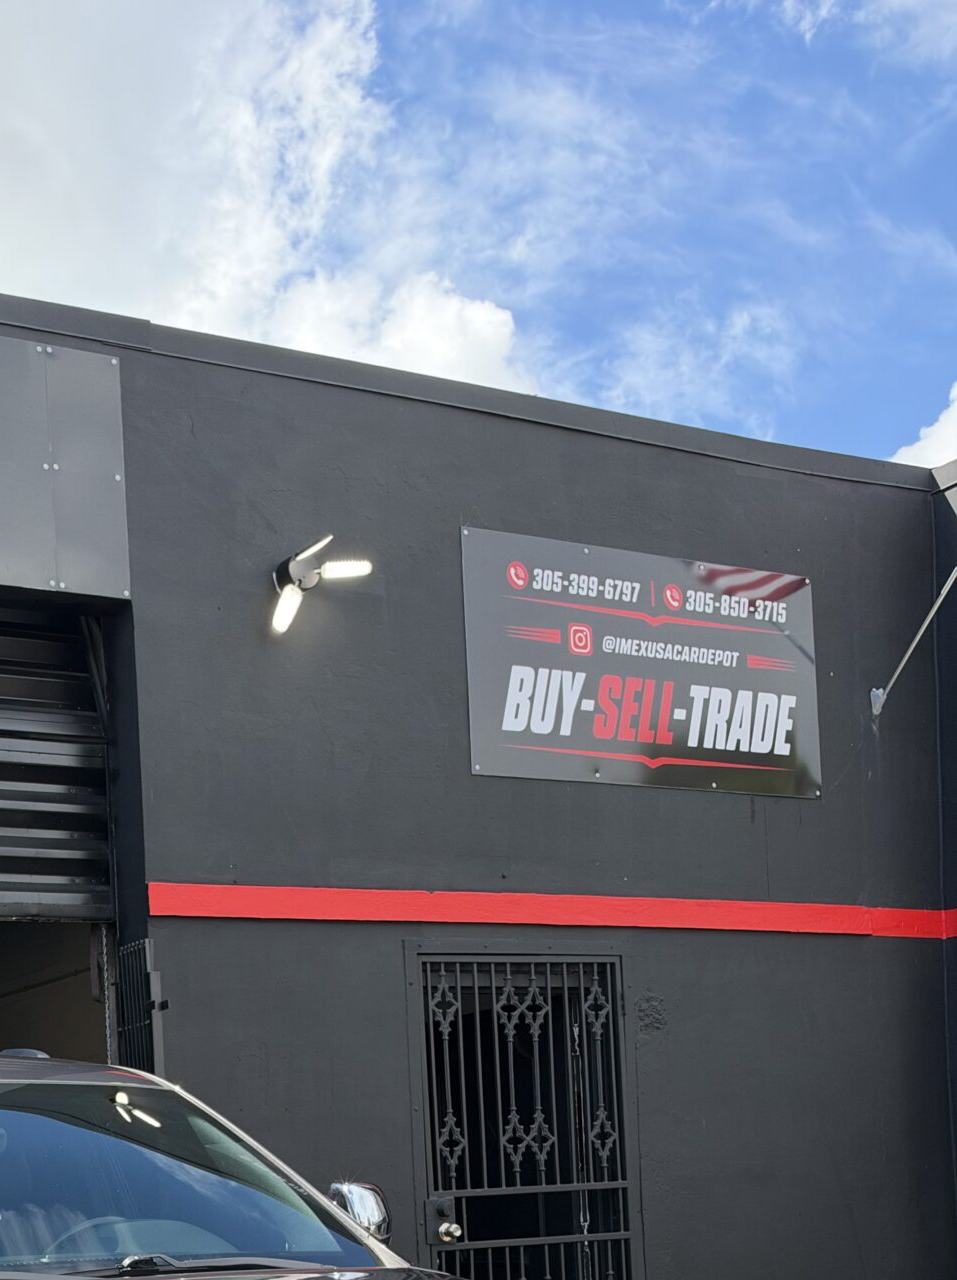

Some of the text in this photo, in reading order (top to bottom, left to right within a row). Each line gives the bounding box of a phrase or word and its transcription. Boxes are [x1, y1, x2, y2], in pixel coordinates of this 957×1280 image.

[532, 568, 787, 623] 305-399-6797 305-850-3715
[601, 635, 740, 669] @IMEXUSACARDEPOT
[501, 664, 797, 756] BUY-SELL-TRADE
